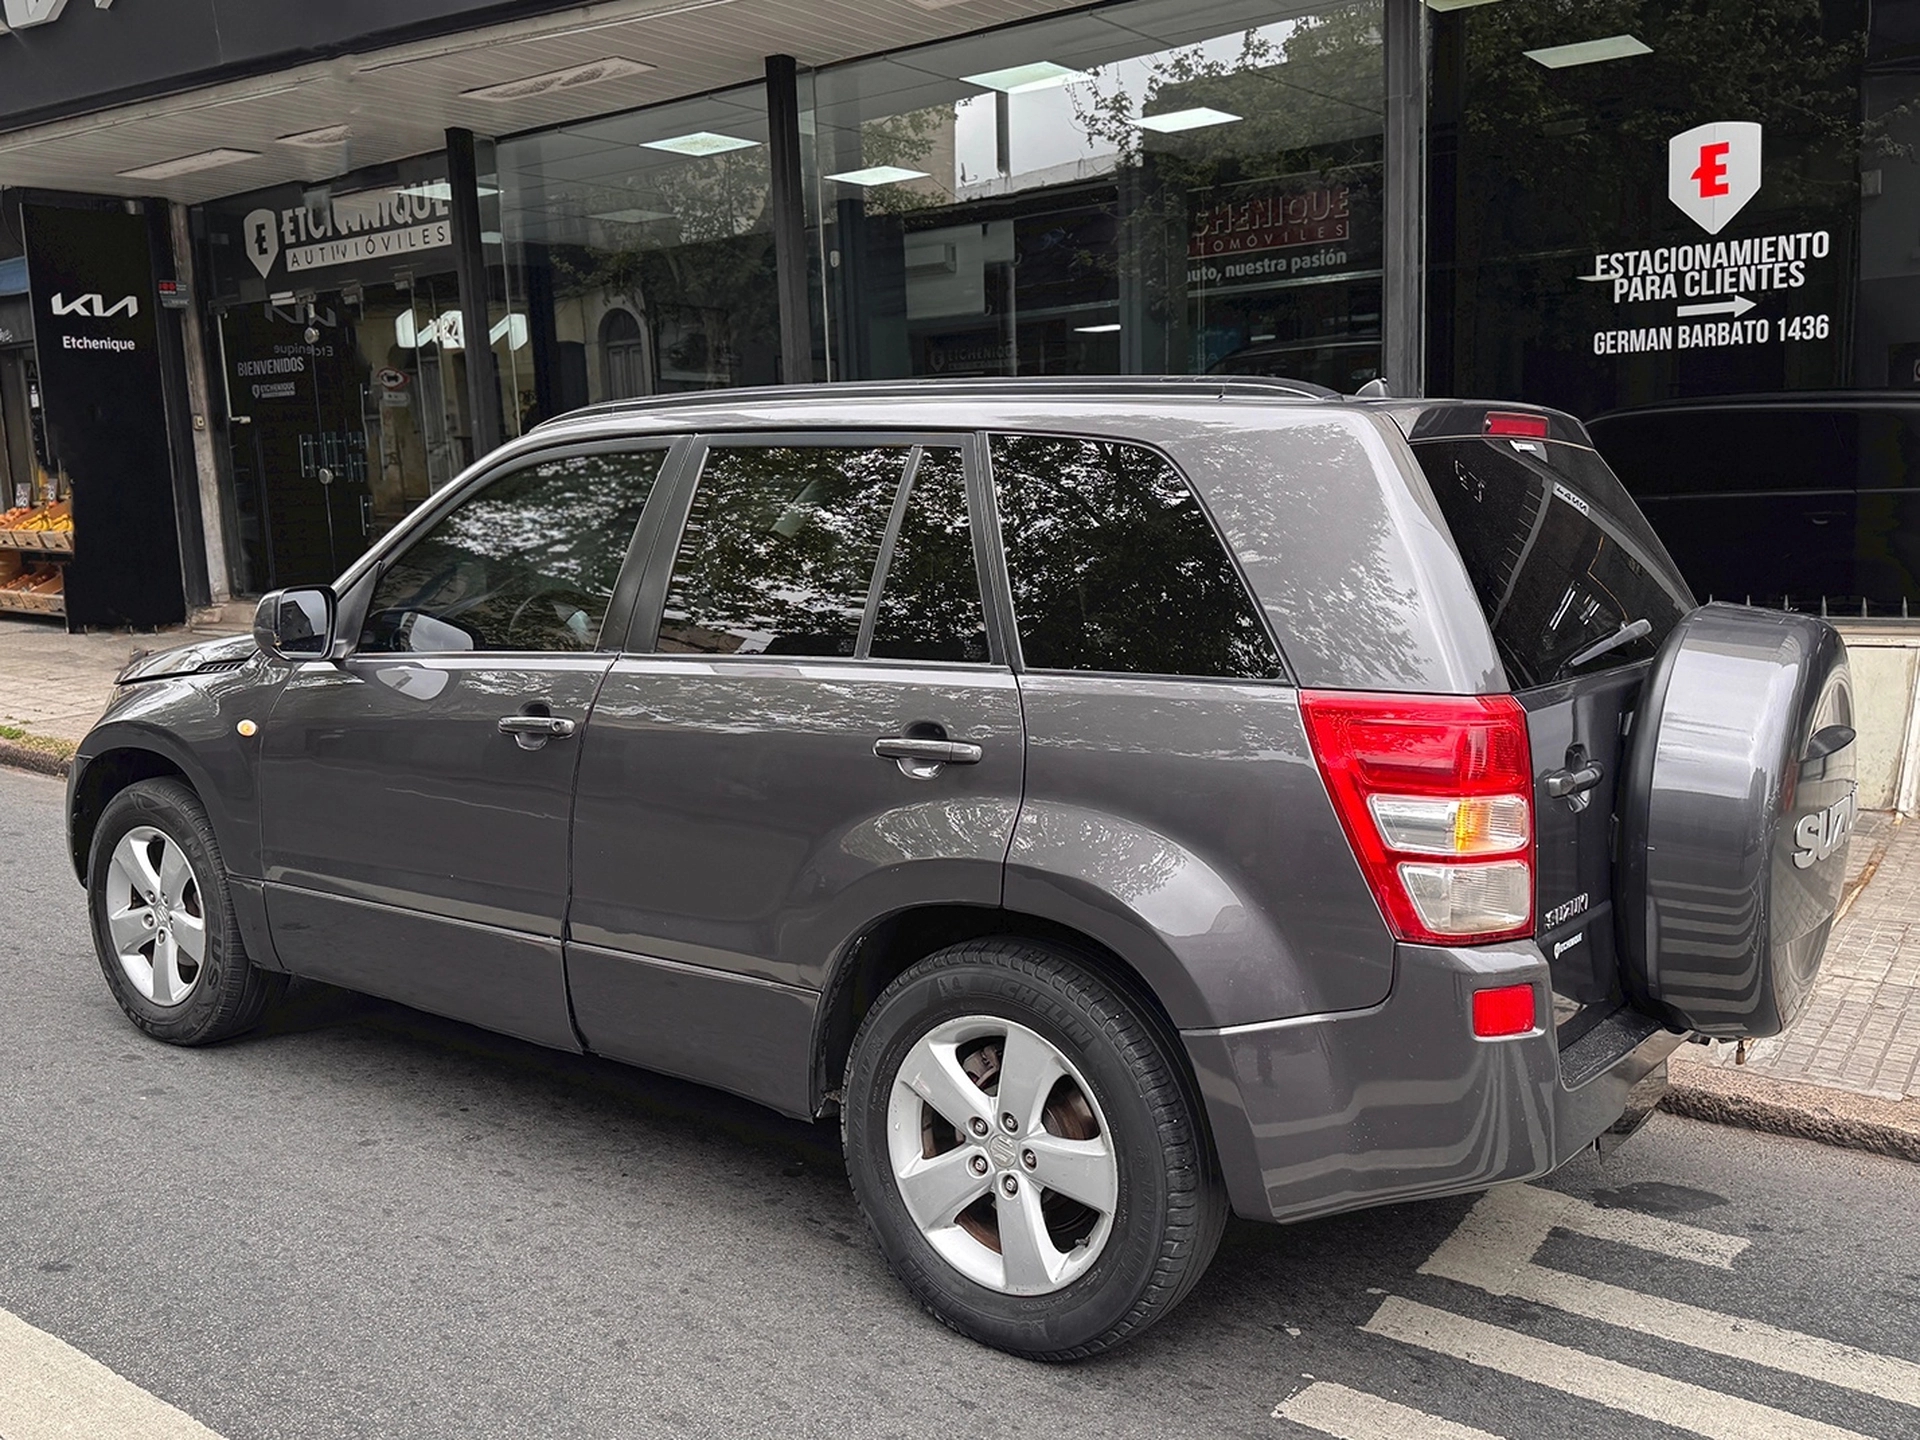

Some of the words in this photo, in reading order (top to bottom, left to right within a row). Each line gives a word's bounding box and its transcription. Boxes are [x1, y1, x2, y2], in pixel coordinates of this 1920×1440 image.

[1225, 257, 1287, 278] nuestra
[1291, 248, 1347, 274] pasión
[1595, 230, 1830, 279] ESTACIONAMIENTO
[1613, 273, 1678, 304] PARA
[1684, 260, 1806, 297] CLIENTES
[62, 335, 136, 352] Etchenique
[1593, 326, 1673, 355] GERMAN
[1677, 319, 1769, 349] BARBATO
[1777, 314, 1830, 342] 1436
[237, 356, 305, 377] BIENVENIDOS
